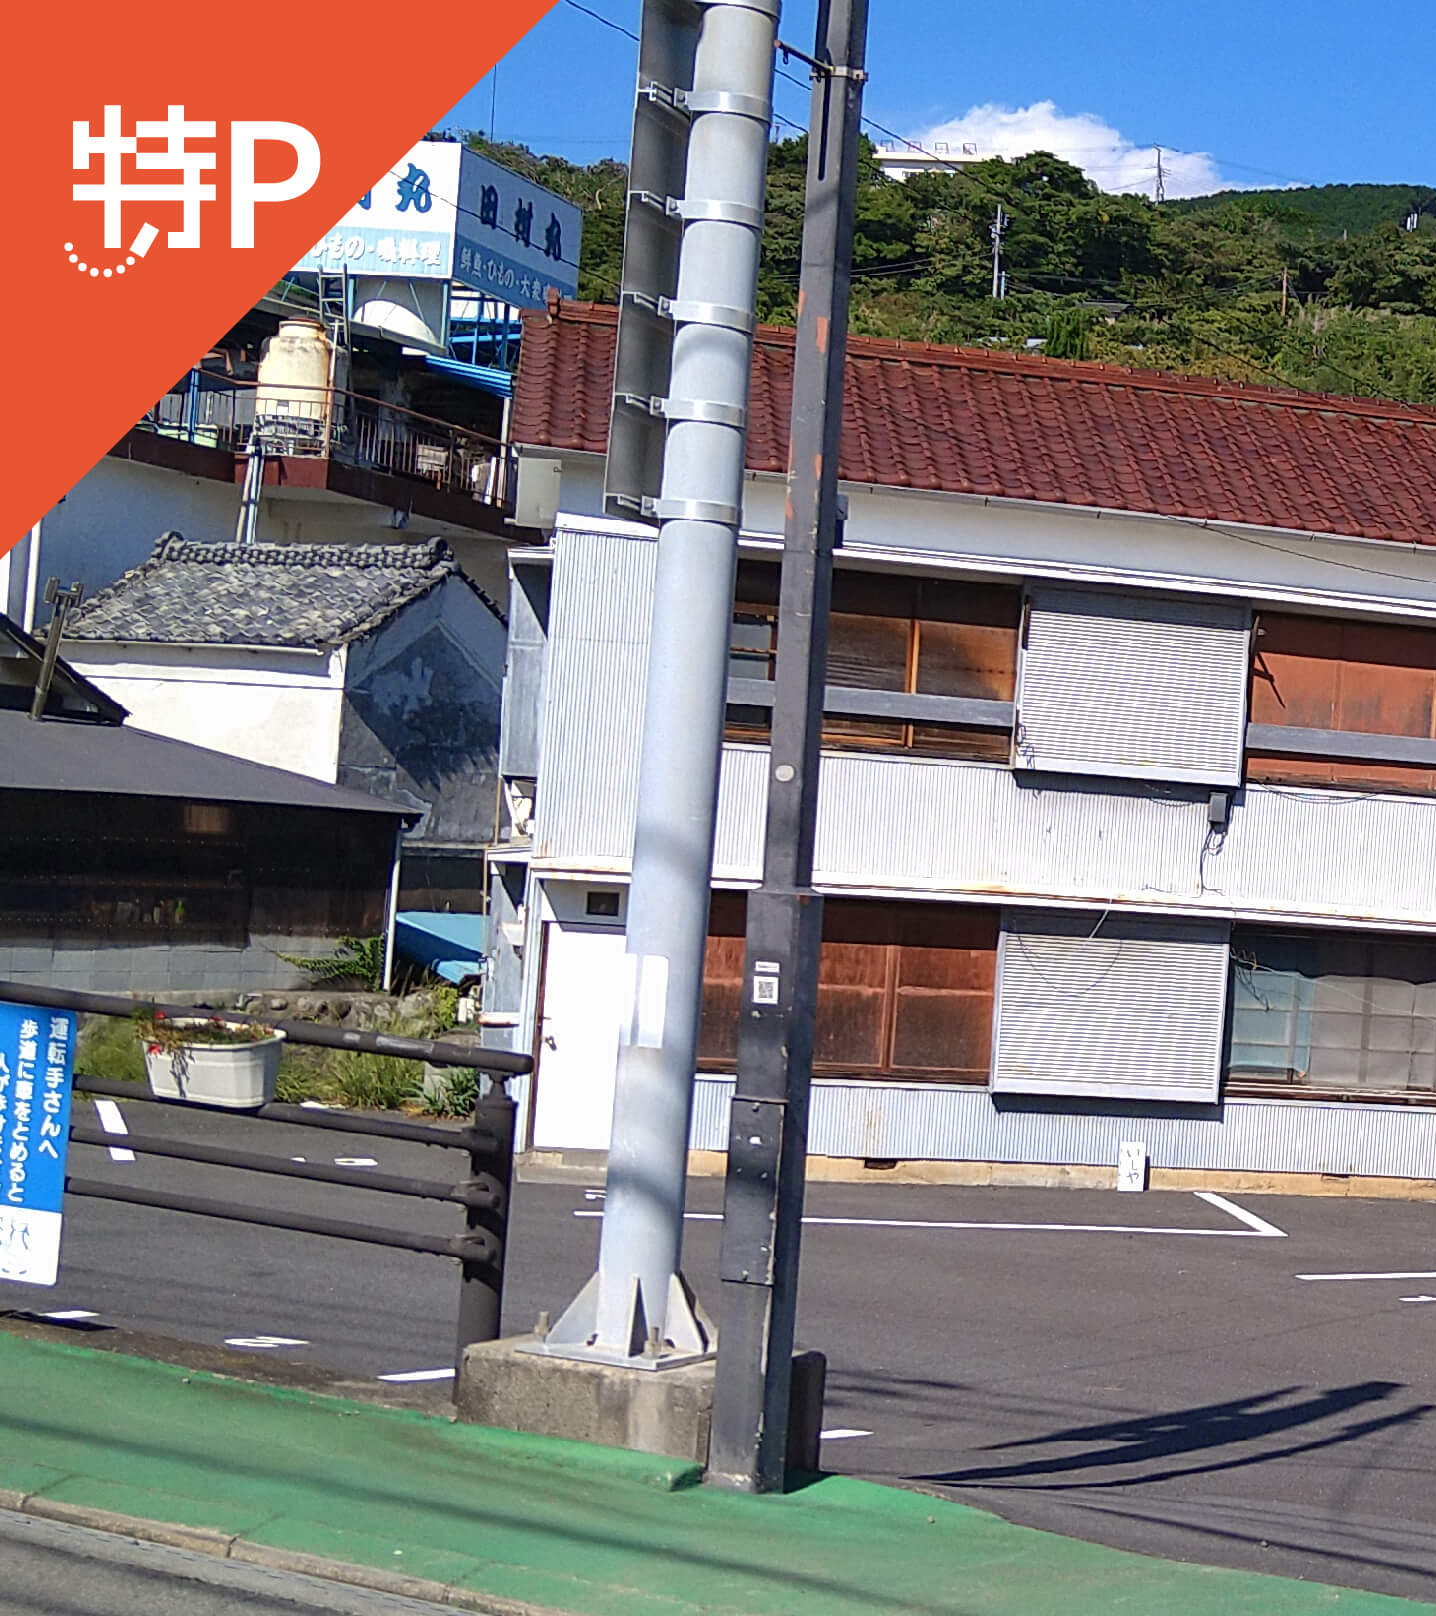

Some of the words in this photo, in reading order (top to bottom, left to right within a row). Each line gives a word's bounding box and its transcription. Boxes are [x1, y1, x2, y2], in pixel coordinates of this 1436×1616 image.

[480, 184, 562, 262] 田村丸
[7, 1018, 39, 1203] 歩道に車をとめると
[38, 1016, 70, 1159] 運転手さんへ
